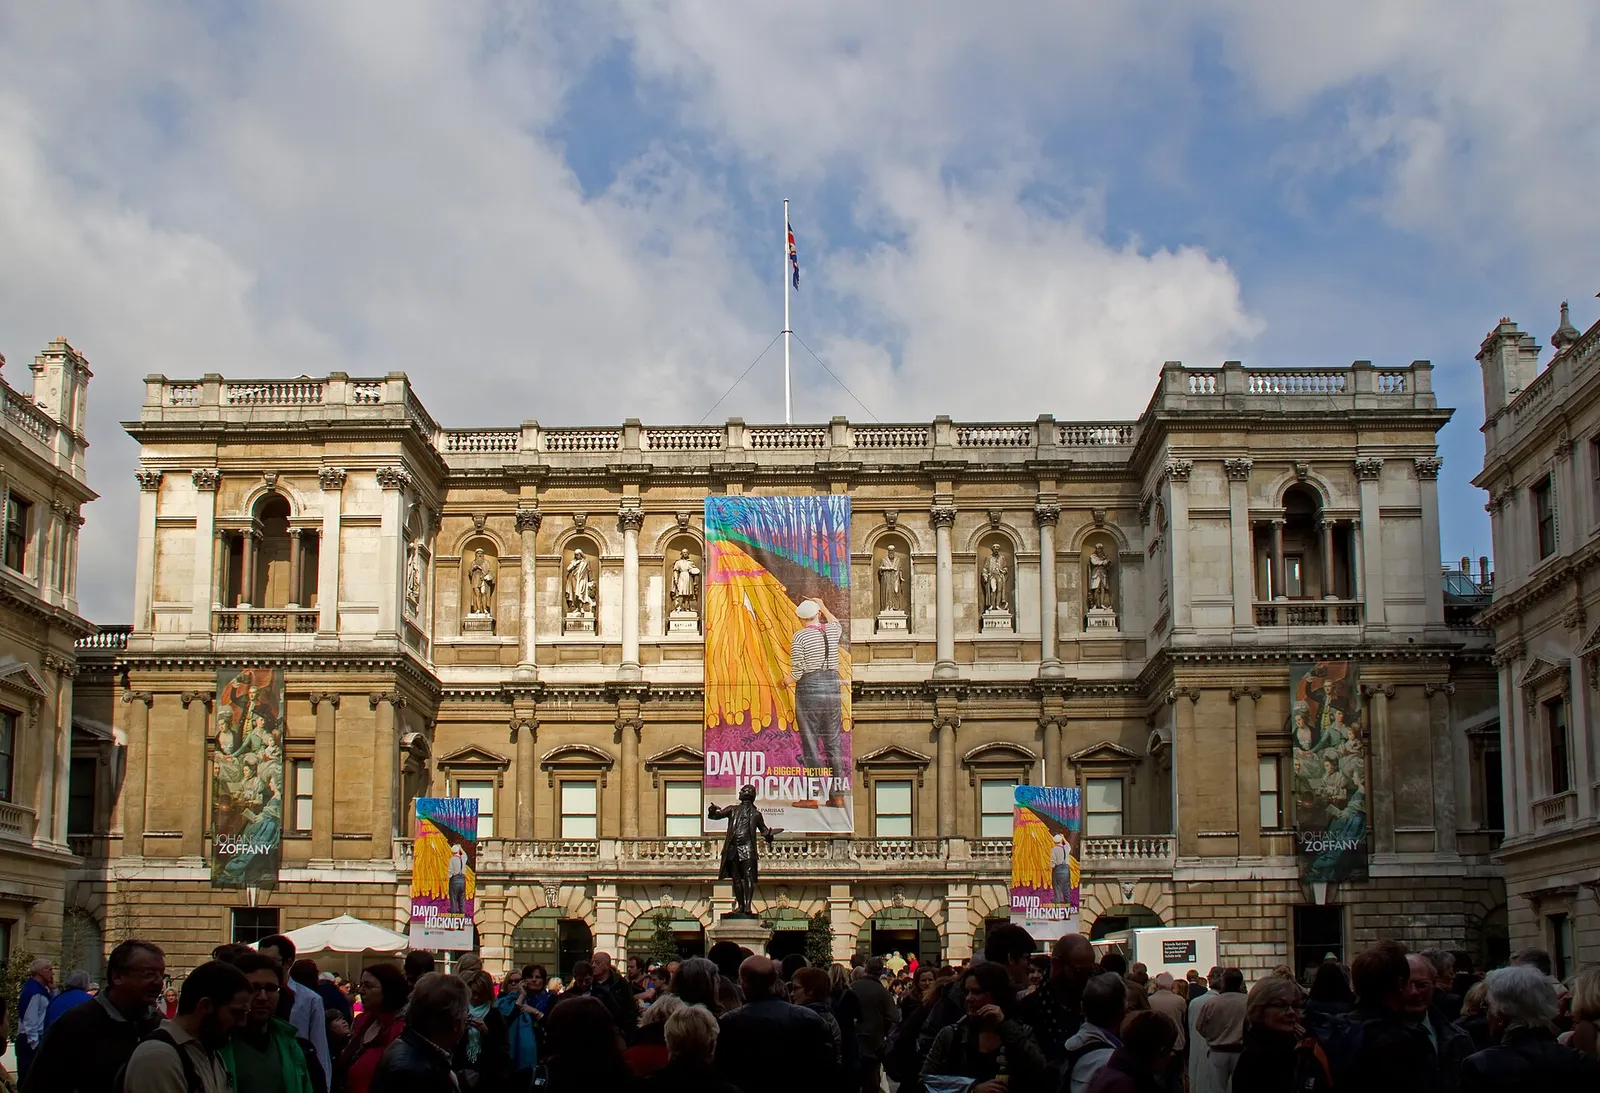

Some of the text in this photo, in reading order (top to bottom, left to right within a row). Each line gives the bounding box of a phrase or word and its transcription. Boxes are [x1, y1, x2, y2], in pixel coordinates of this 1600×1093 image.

[706, 751, 766, 776] DAVID
[766, 766, 833, 777] A BIGGER PICTURE
[735, 775, 850, 801] HOCKNEY RA
[218, 844, 272, 854] ZOFFANY
[1304, 840, 1360, 852] ZOFFANY
[1012, 896, 1040, 908] DAVID
[412, 905, 438, 916] DAVID
[1026, 907, 1070, 919] HOCKNEY
[424, 916, 464, 929] HOCKNEY
